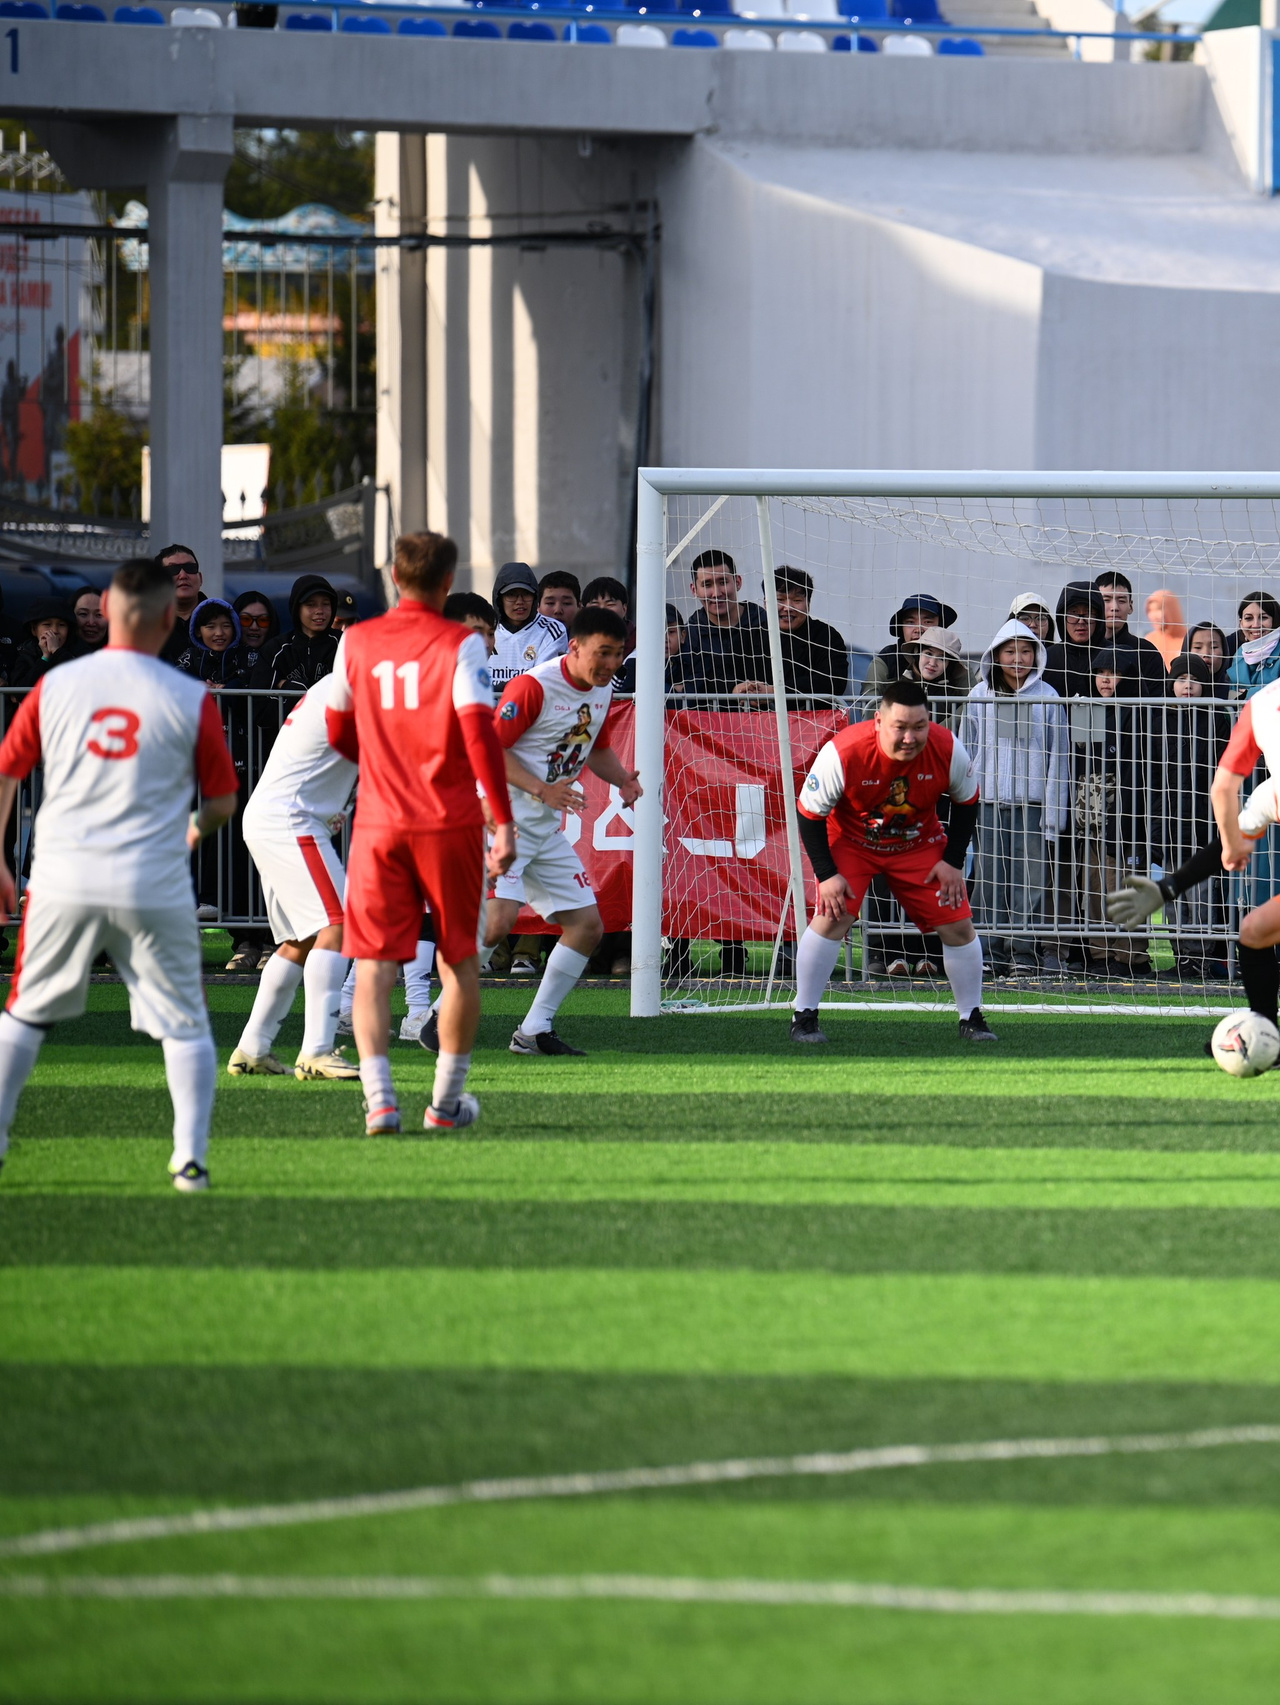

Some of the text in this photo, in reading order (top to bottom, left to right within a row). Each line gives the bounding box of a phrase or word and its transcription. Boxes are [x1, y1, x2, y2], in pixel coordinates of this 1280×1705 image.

[5, 27, 20, 75] 1
[371, 660, 420, 710] 11
[87, 706, 141, 760] 3
